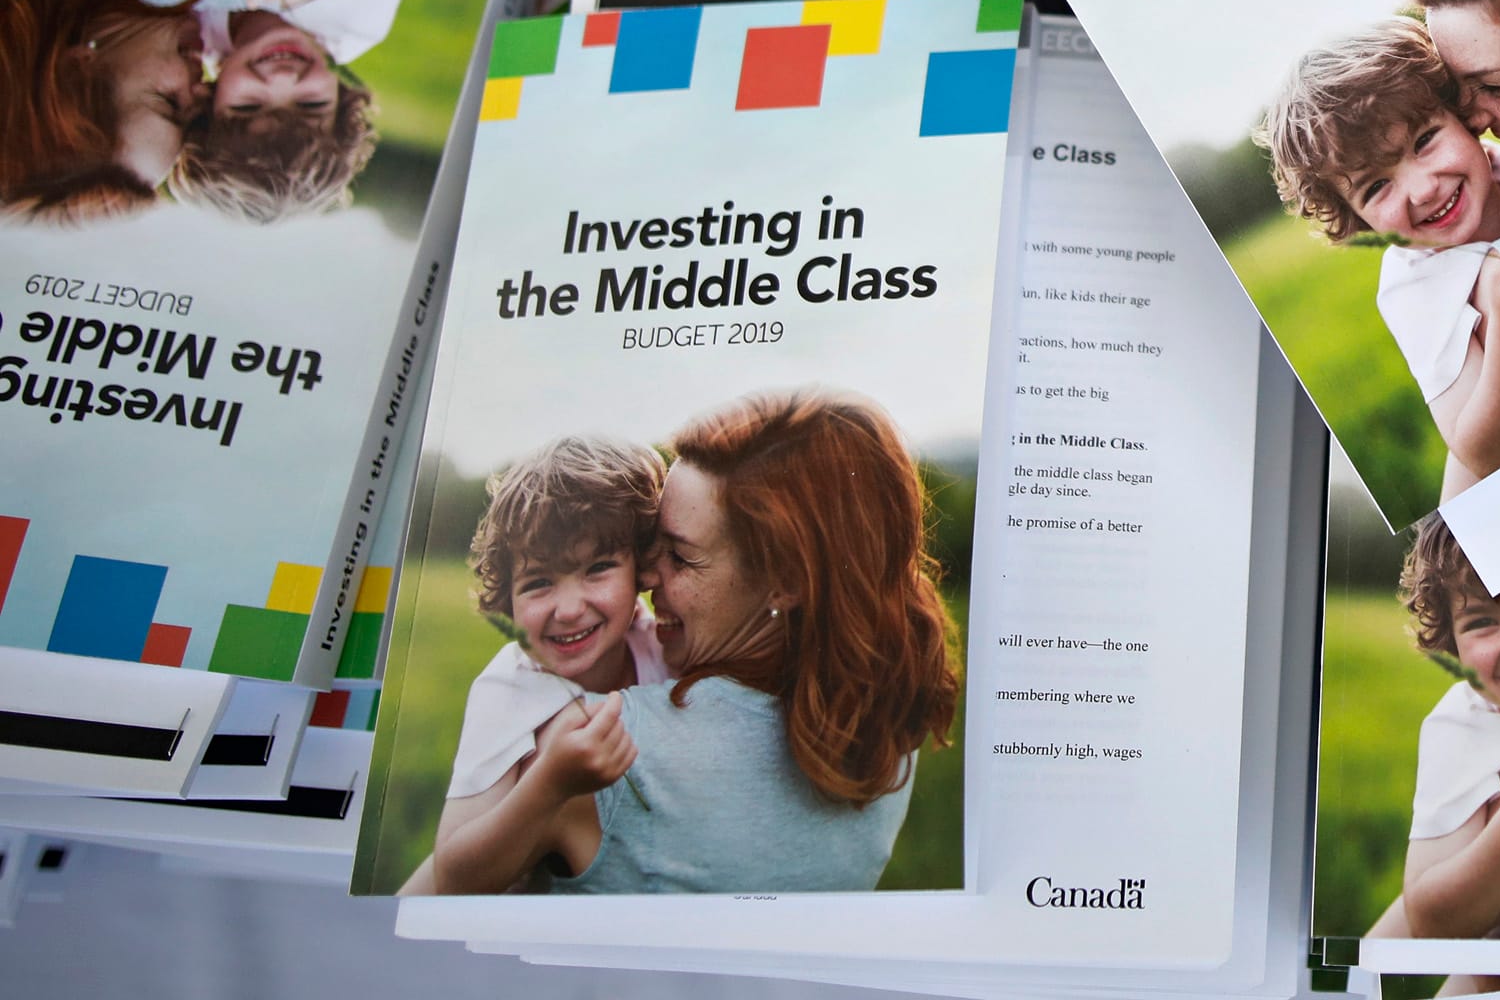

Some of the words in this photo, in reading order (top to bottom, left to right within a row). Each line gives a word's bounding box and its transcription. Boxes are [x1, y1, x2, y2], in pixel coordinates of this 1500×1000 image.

[1053, 144, 1116, 166] Class
[563, 200, 802, 257] Investing
[818, 195, 865, 240] in
[1032, 242, 1058, 255] with
[1061, 245, 1093, 256] some
[1096, 246, 1133, 261] young
[1136, 249, 1176, 263] people
[25, 274, 84, 300] 2019
[497, 270, 579, 319] the
[594, 258, 780, 313] Middle
[797, 254, 939, 303] Class
[1045, 288, 1067, 301] like
[1070, 290, 1096, 302] kids
[1099, 291, 1127, 305] their
[1130, 296, 1151, 308] age
[84, 282, 193, 316] BUDGET
[19, 311, 217, 380] Middle
[622, 324, 724, 350] BUDGET
[728, 321, 784, 345] 2019
[230, 340, 323, 395] the
[1019, 433, 1031, 445] in
[1035, 434, 1056, 446] the
[1060, 435, 1106, 448] Middle
[1110, 438, 1148, 450] Class.
[321, 521, 367, 651] Investing
[361, 488, 375, 514] in
[371, 437, 391, 481] the
[385, 335, 418, 429] Middle
[414, 260, 440, 326] Class
[1014, 466, 1033, 477] the
[1037, 467, 1080, 479] middle
[1083, 469, 1113, 481] class
[1117, 471, 1153, 485] began
[1030, 484, 1052, 497] day
[1056, 485, 1091, 497] since.
[1026, 517, 1076, 532] promise
[1080, 518, 1096, 530] of
[1096, 521, 1104, 531] a
[1108, 520, 1143, 533] better
[1074, 690, 1112, 703] where
[1117, 694, 1135, 705] we
[993, 743, 1061, 757] stubbornly
[1065, 745, 1098, 759] high,
[1103, 747, 1142, 760] wages
[1026, 876, 1145, 909] Canada
